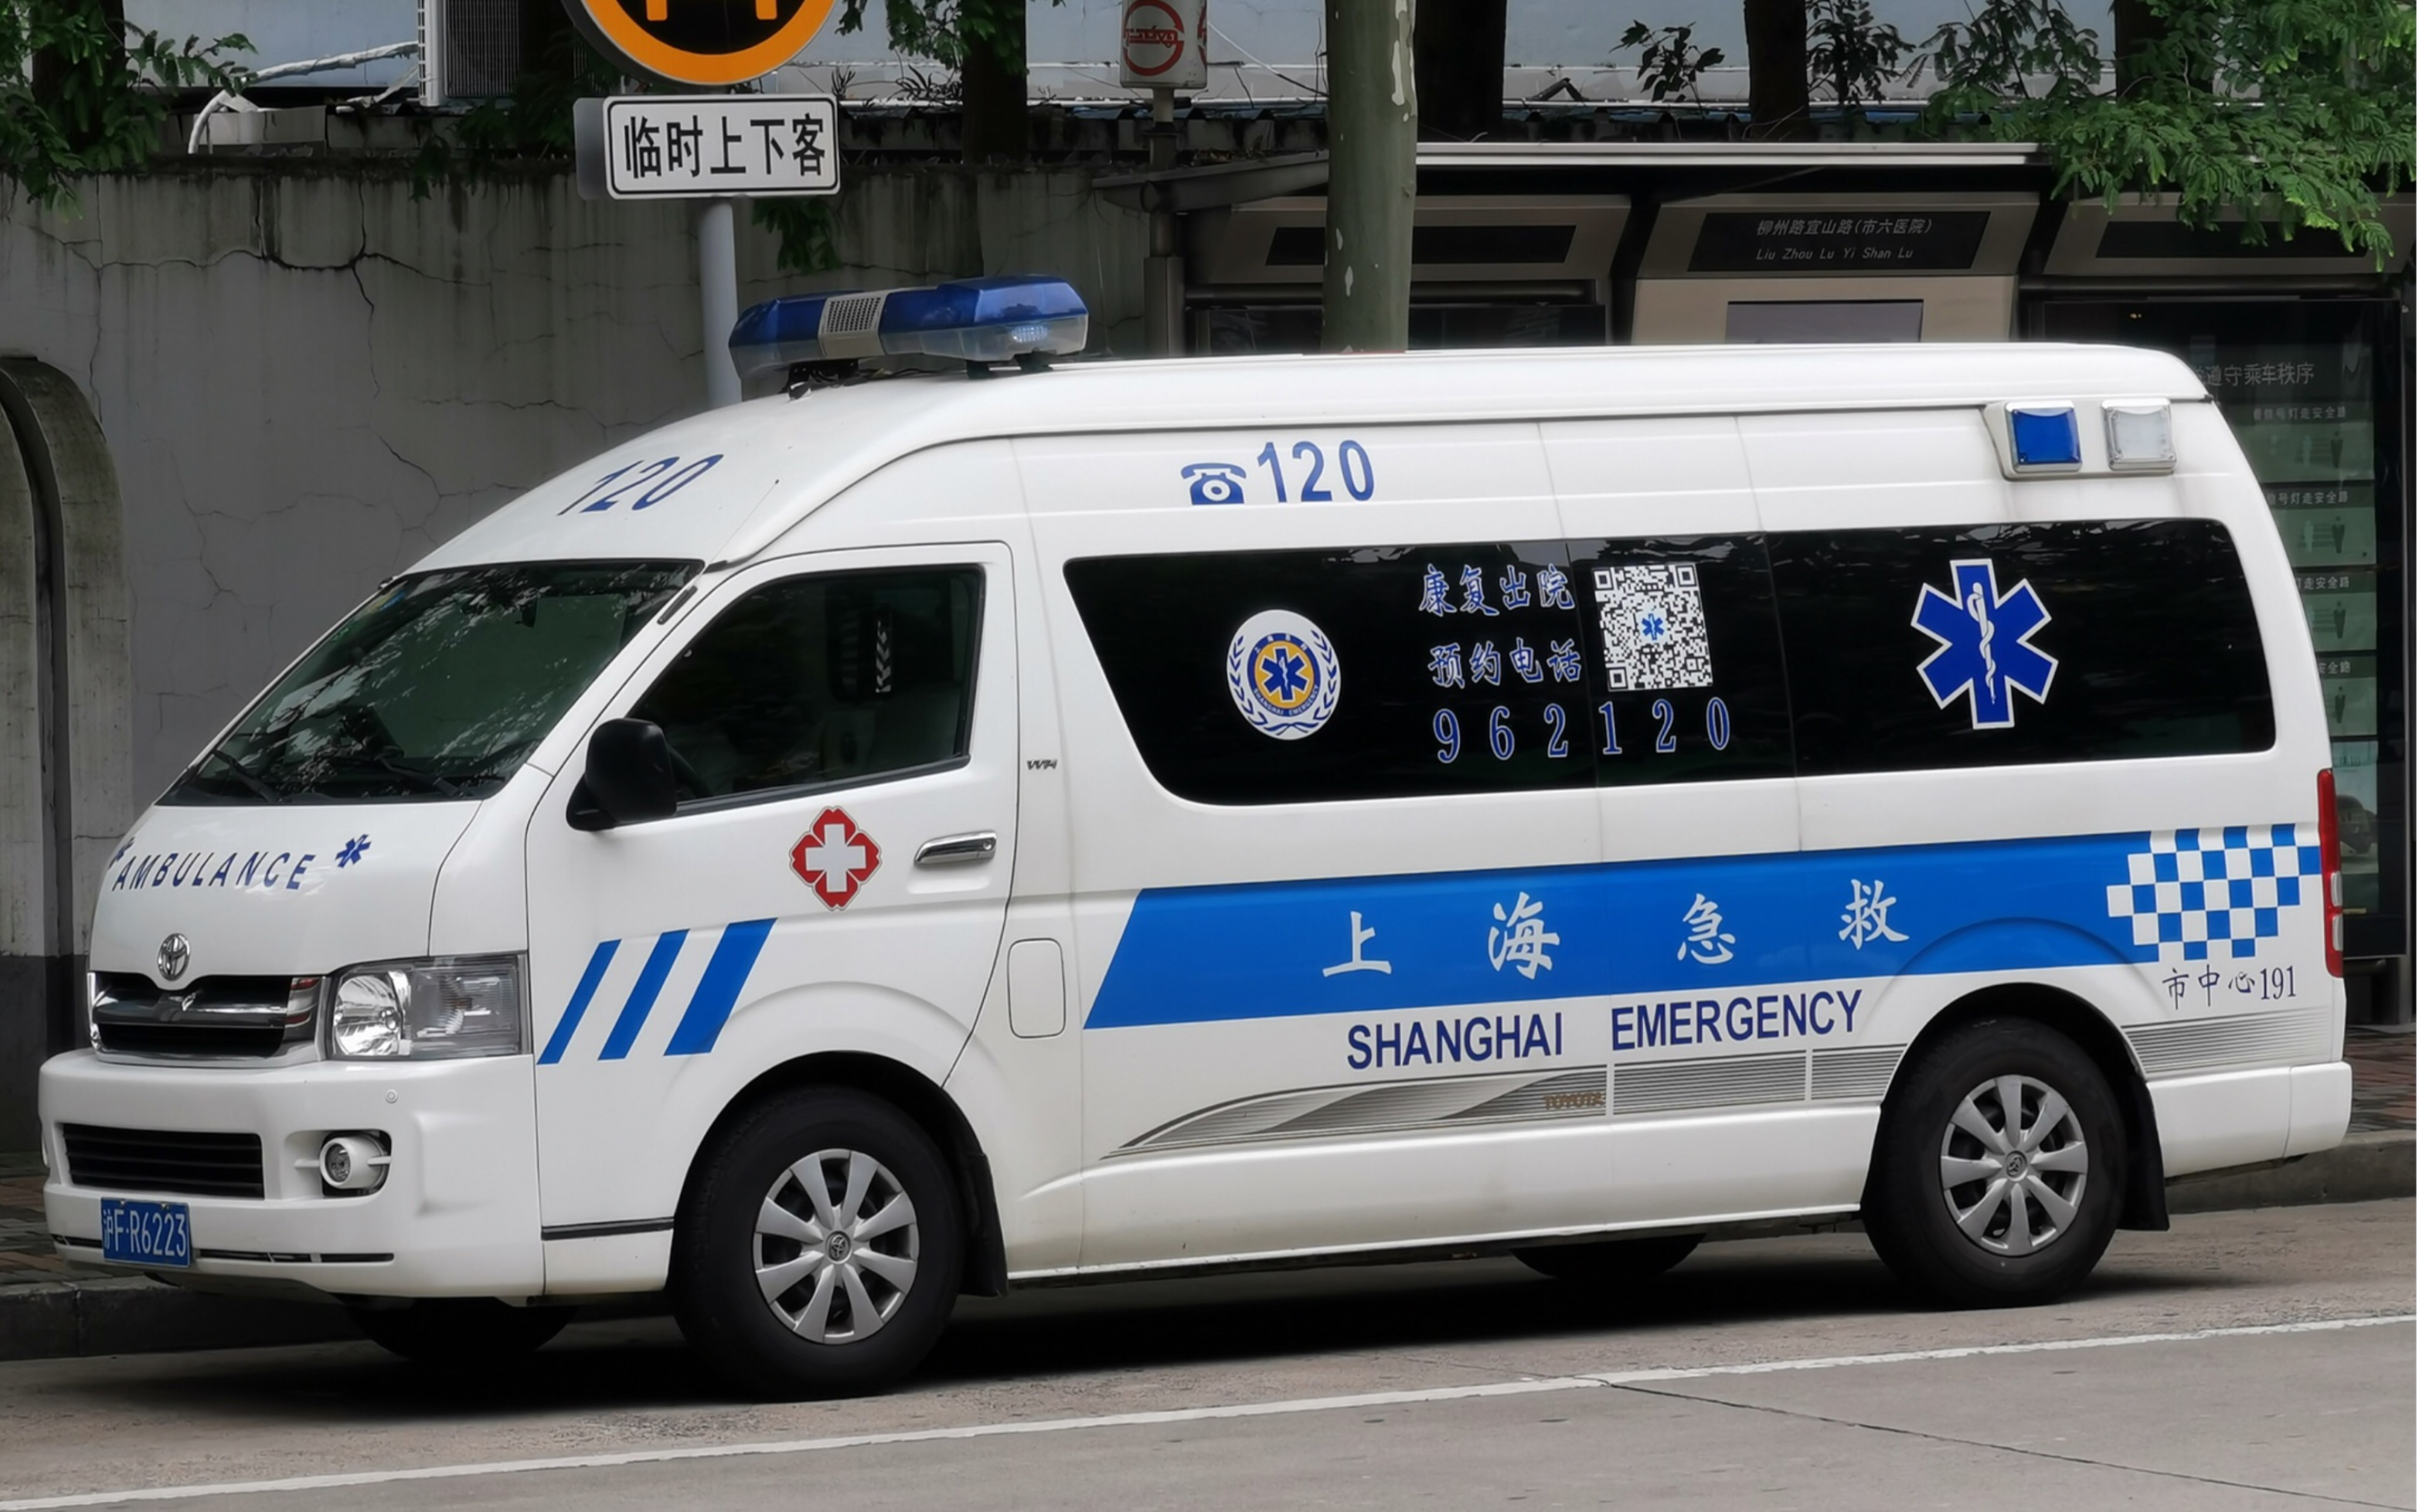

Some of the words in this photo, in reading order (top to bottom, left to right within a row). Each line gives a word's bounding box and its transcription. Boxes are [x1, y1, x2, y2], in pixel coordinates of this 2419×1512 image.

[624, 113, 826, 179] 临时上下客
[1756, 248, 1776, 261] Liu
[1781, 247, 1813, 260] Zhou
[1819, 248, 1835, 260] Lu
[1843, 246, 1856, 260] Yi
[1862, 246, 1892, 260] Shan
[1897, 246, 1914, 259] Lu
[556, 454, 724, 516] 120
[1257, 440, 1375, 503] 120
[1418, 562, 1576, 617] 康复出院
[1427, 637, 1581, 689] 预约电话
[1433, 696, 1731, 764] 962120
[112, 851, 316, 892] AMBULANCE
[1322, 878, 1910, 980] 上海急救
[1347, 1012, 1563, 1071] SHANGHAI
[1611, 990, 1863, 1052] EMERGENCY
